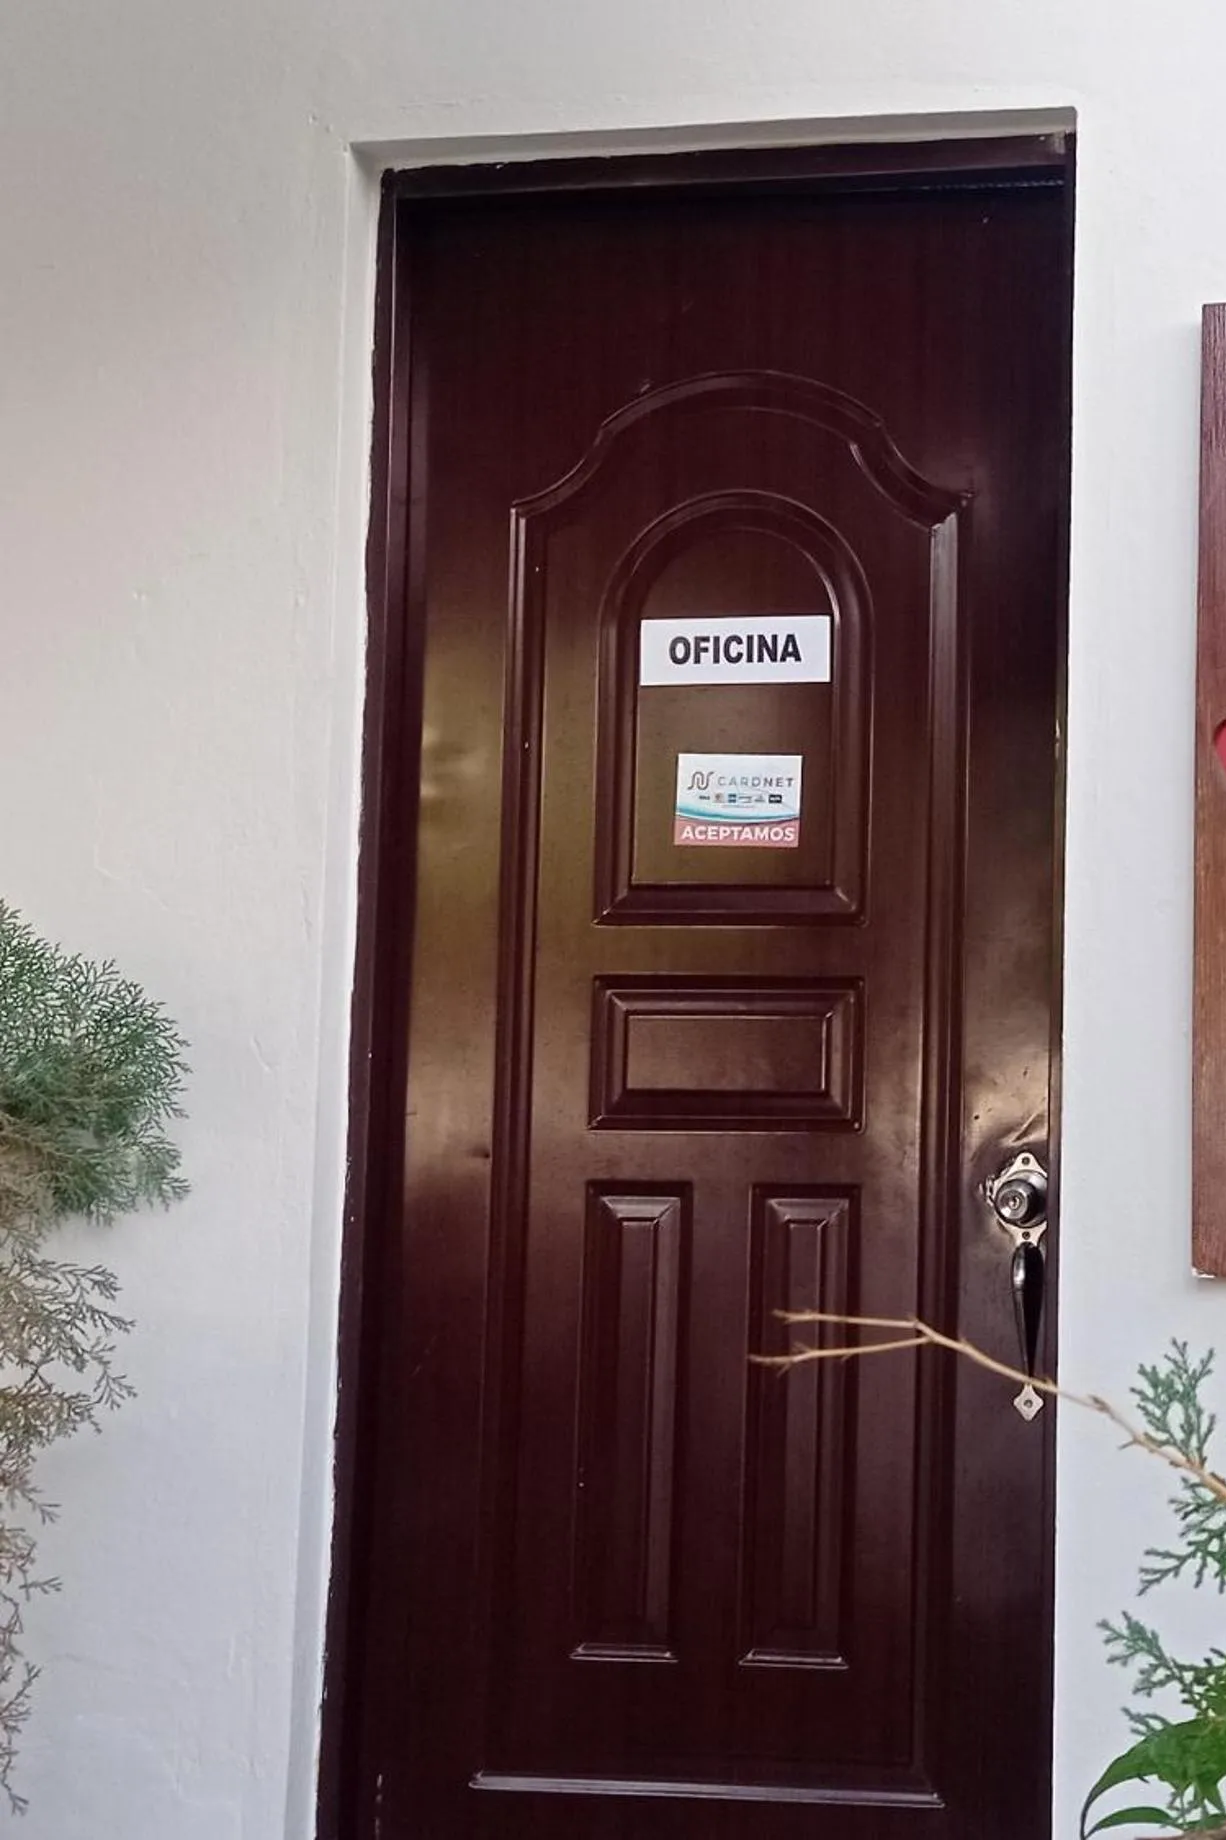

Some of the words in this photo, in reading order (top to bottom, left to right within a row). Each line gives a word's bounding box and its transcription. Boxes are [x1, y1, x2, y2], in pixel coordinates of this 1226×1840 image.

[669, 633, 802, 665] OFICINA
[718, 776, 794, 788] CARDNET
[681, 825, 795, 841] ACEPTAMOS
